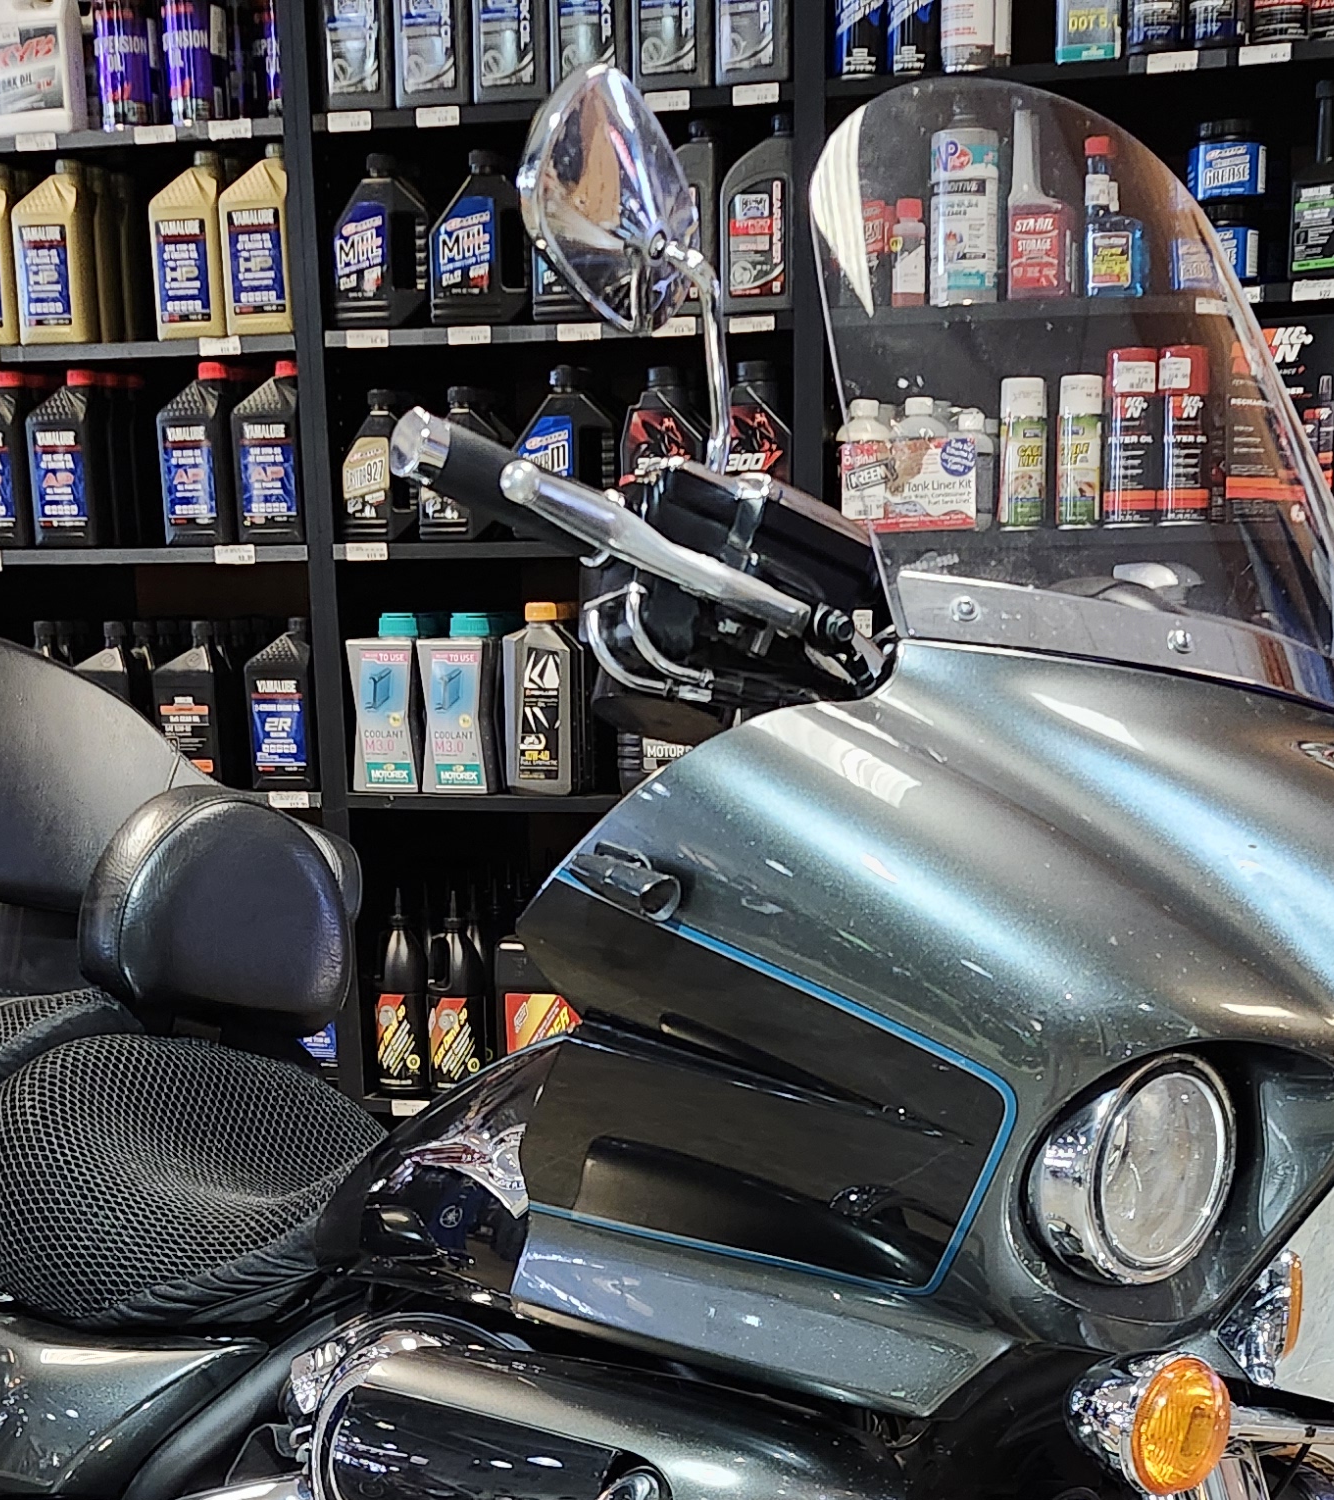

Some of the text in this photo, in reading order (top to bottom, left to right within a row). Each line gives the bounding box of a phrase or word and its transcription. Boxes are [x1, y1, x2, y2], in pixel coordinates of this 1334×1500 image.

[20, 73, 33, 89] OIL
[1203, 163, 1250, 188] GREASE
[231, 208, 275, 226] YAMALUBE
[21, 226, 62, 241] YAMALUBE
[159, 219, 201, 236] YAMALUBE
[1017, 238, 1052, 251] STORAGE
[35, 431, 76, 446] YAMALUBE
[166, 425, 206, 441] YAMALUBE
[243, 423, 286, 439] YAMALUBE
[725, 449, 784, 473] 300V
[367, 460, 385, 484] 927
[849, 465, 891, 490] KREEM
[906, 482, 931, 491] Tank
[931, 481, 956, 491] Liner
[957, 479, 973, 490] Kit
[379, 652, 405, 662] TO USE
[450, 653, 475, 663] TO USE
[256, 679, 298, 693] YAMALUBE
[264, 717, 292, 732] 2R
[364, 730, 404, 740] COOLANT
[434, 731, 474, 740] COOLANT
[365, 740, 395, 751] M3.0
[434, 741, 464, 752] M3.0
[371, 769, 409, 780] MOTOREX
[440, 770, 478, 781] MOTOREX
